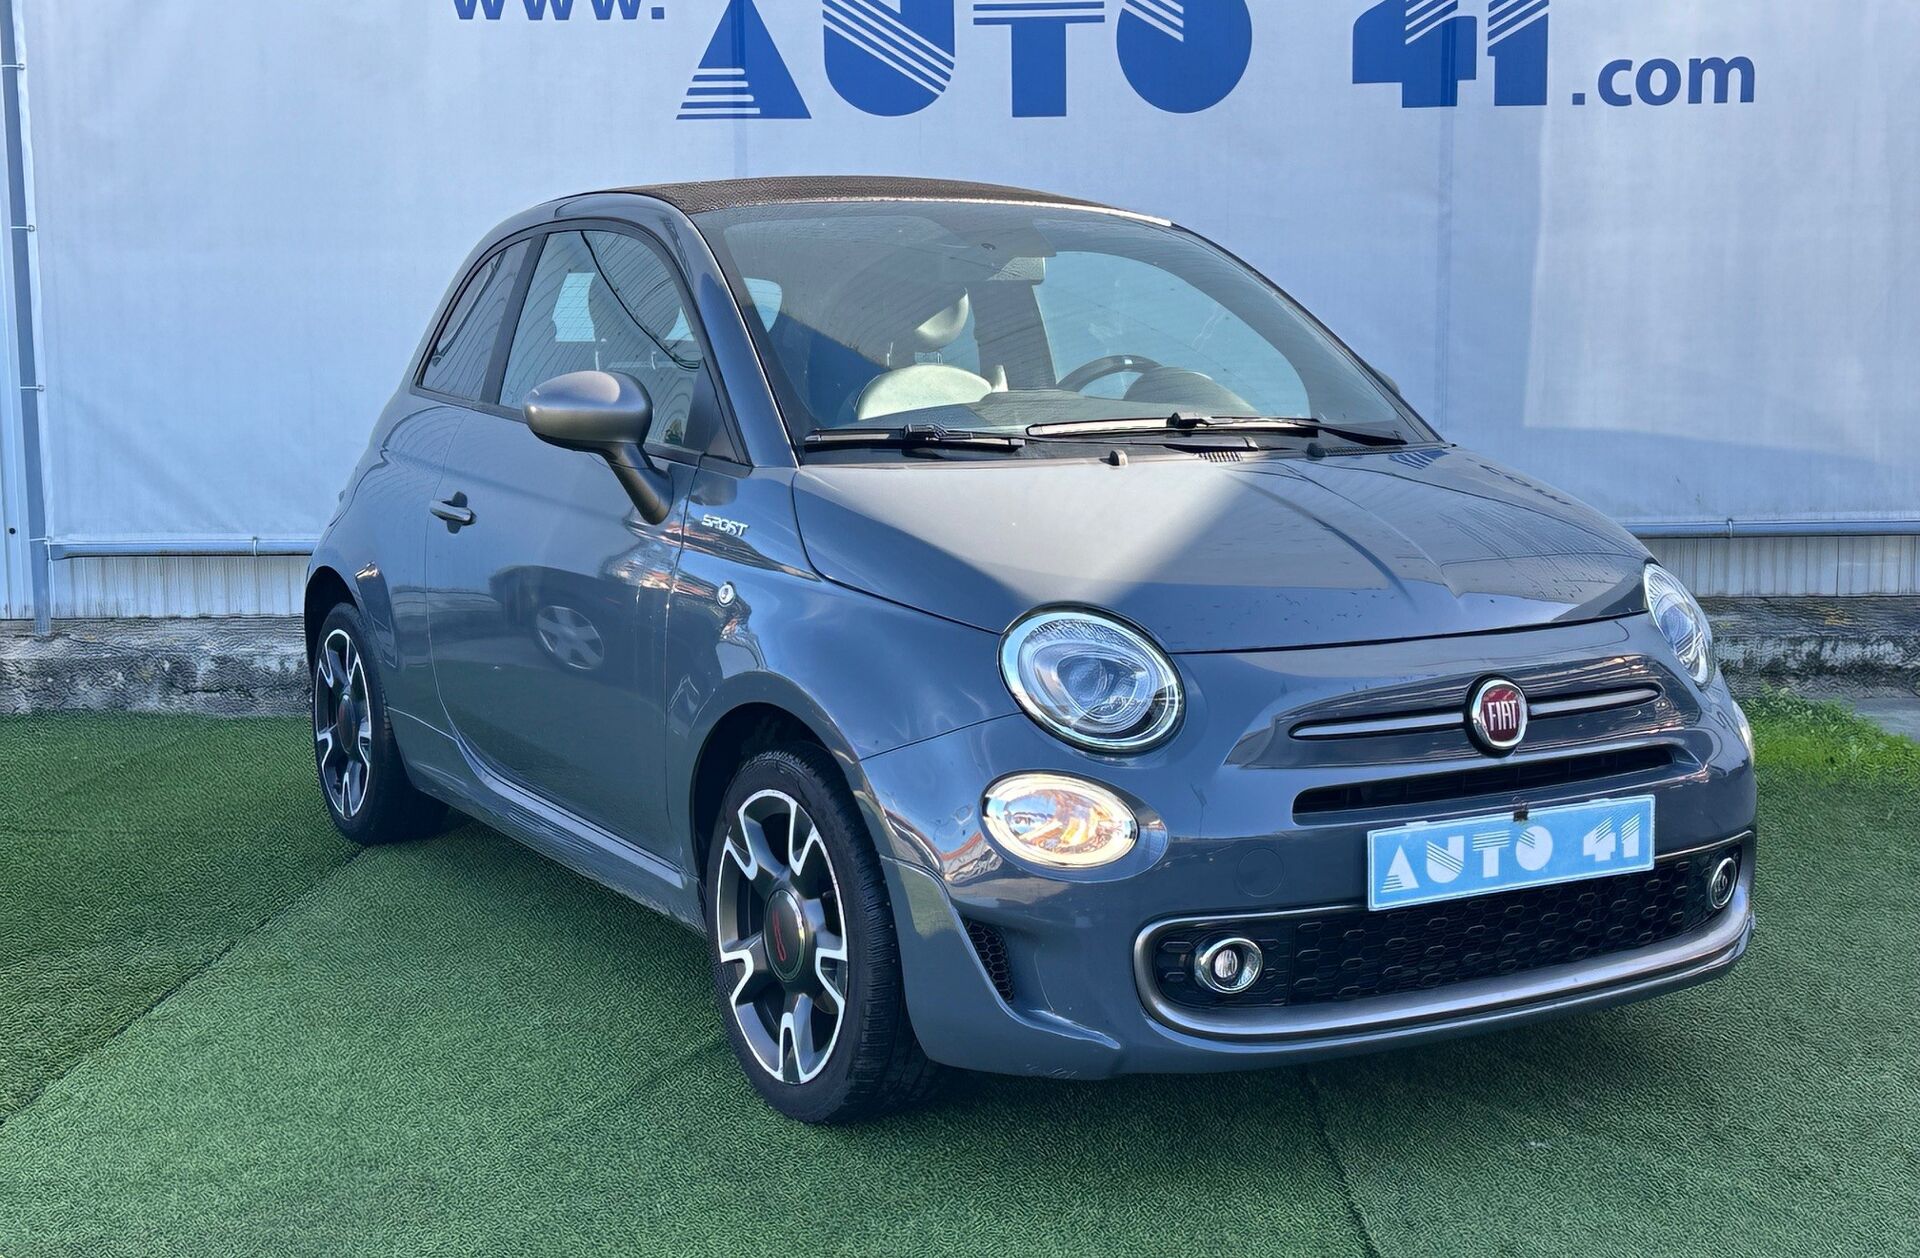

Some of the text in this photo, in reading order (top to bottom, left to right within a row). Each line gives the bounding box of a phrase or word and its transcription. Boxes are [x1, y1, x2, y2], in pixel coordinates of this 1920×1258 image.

[702, 514, 748, 536] SPORT
[1487, 700, 1517, 731] FIAT
[1381, 814, 1640, 894] AUTO 41
